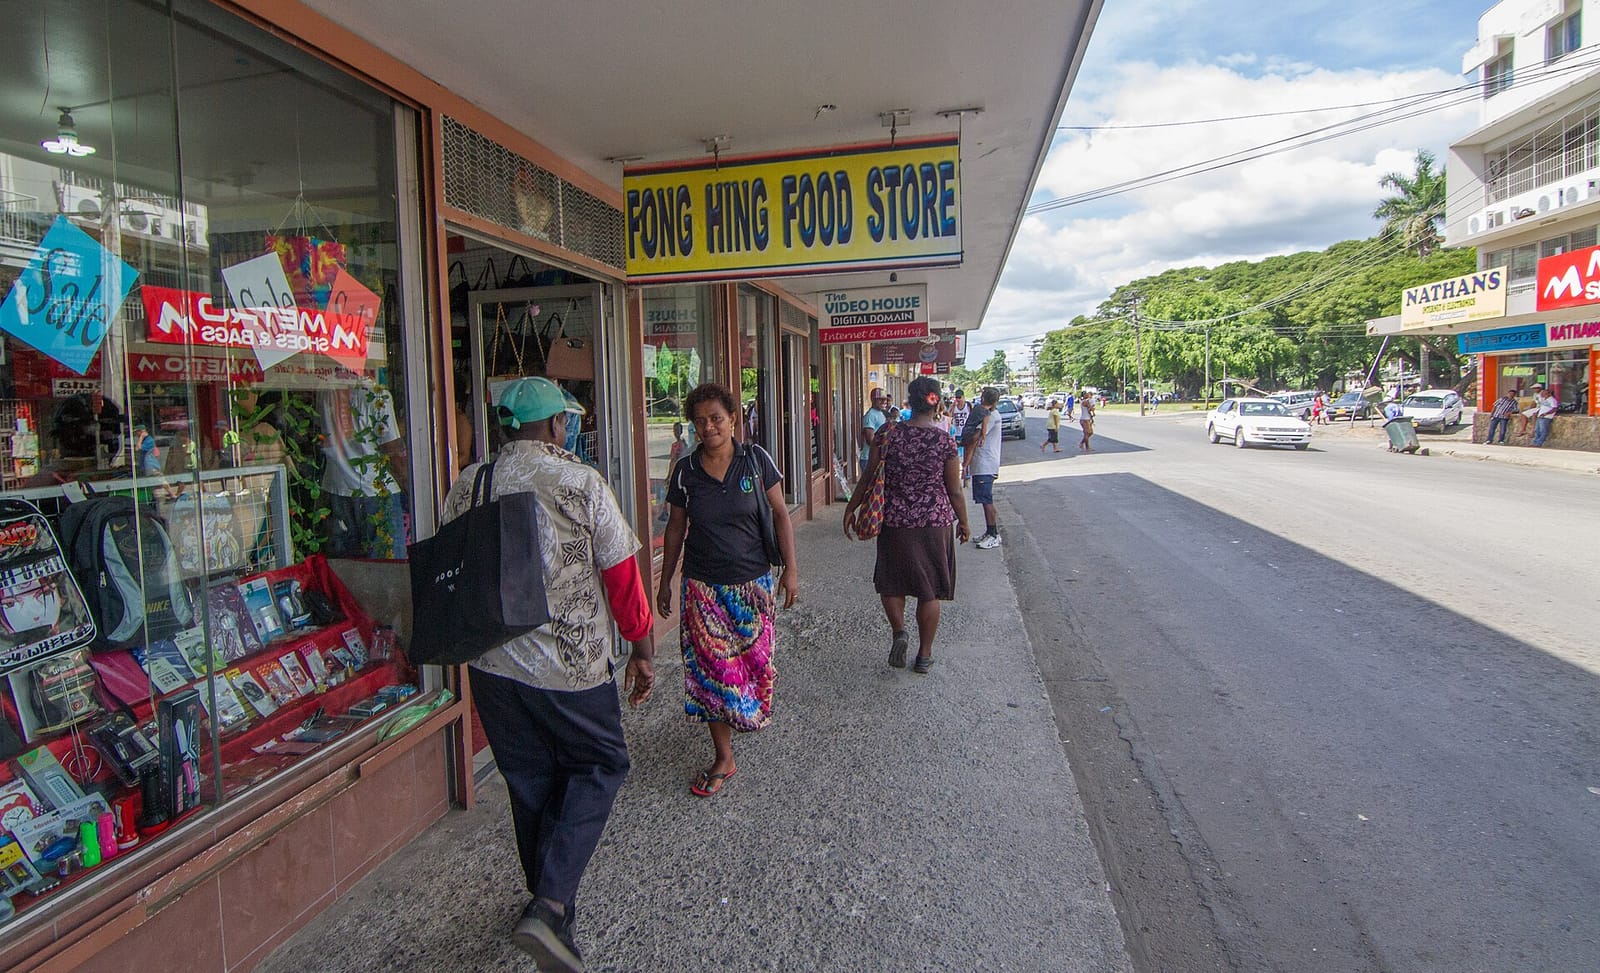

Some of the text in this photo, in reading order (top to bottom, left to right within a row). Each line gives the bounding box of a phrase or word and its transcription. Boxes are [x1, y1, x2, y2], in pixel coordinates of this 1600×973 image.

[627, 160, 957, 259] FONG HING FOOD STORE
[26, 248, 111, 346] Sale
[1405, 271, 1501, 307] NATHANS
[825, 293, 847, 302] The
[825, 296, 920, 314] VIDEO HOUSE
[833, 311, 912, 326] DIGITAL DOMAIN
[824, 330, 867, 341] Internet
[868, 329, 877, 338] &
[880, 327, 923, 337] Gaming
[146, 600, 170, 613] NIKE
